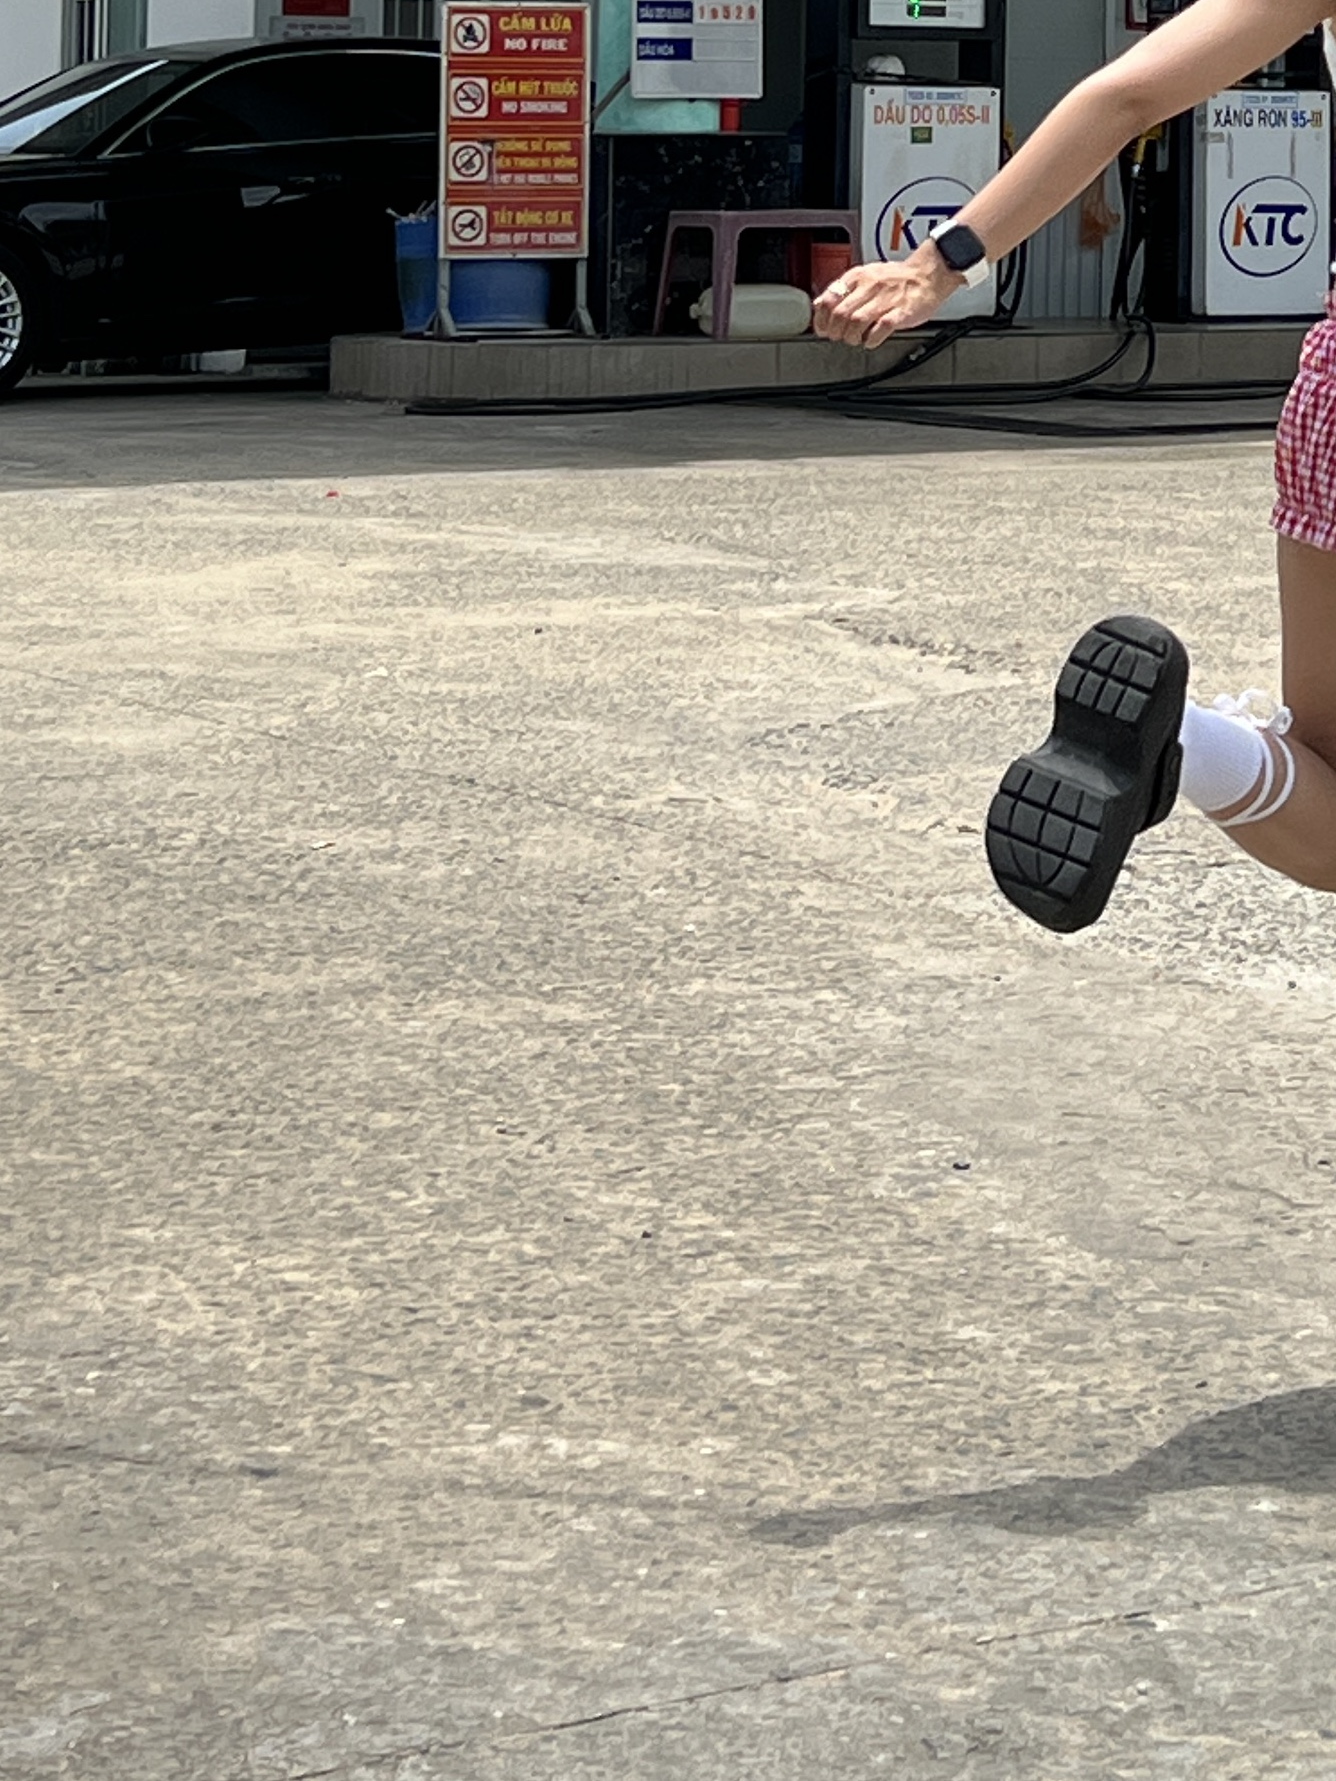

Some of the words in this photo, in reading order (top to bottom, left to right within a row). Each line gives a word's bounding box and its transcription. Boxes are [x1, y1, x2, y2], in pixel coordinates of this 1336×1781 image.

[499, 11, 536, 32] CẤM
[504, 38, 527, 51] NO
[531, 38, 568, 51] FIRE
[911, 105, 932, 125] DO
[1213, 105, 1254, 128] XĂNG
[1258, 109, 1288, 128] RON
[890, 205, 966, 251] KT
[1232, 203, 1308, 247] KTC
